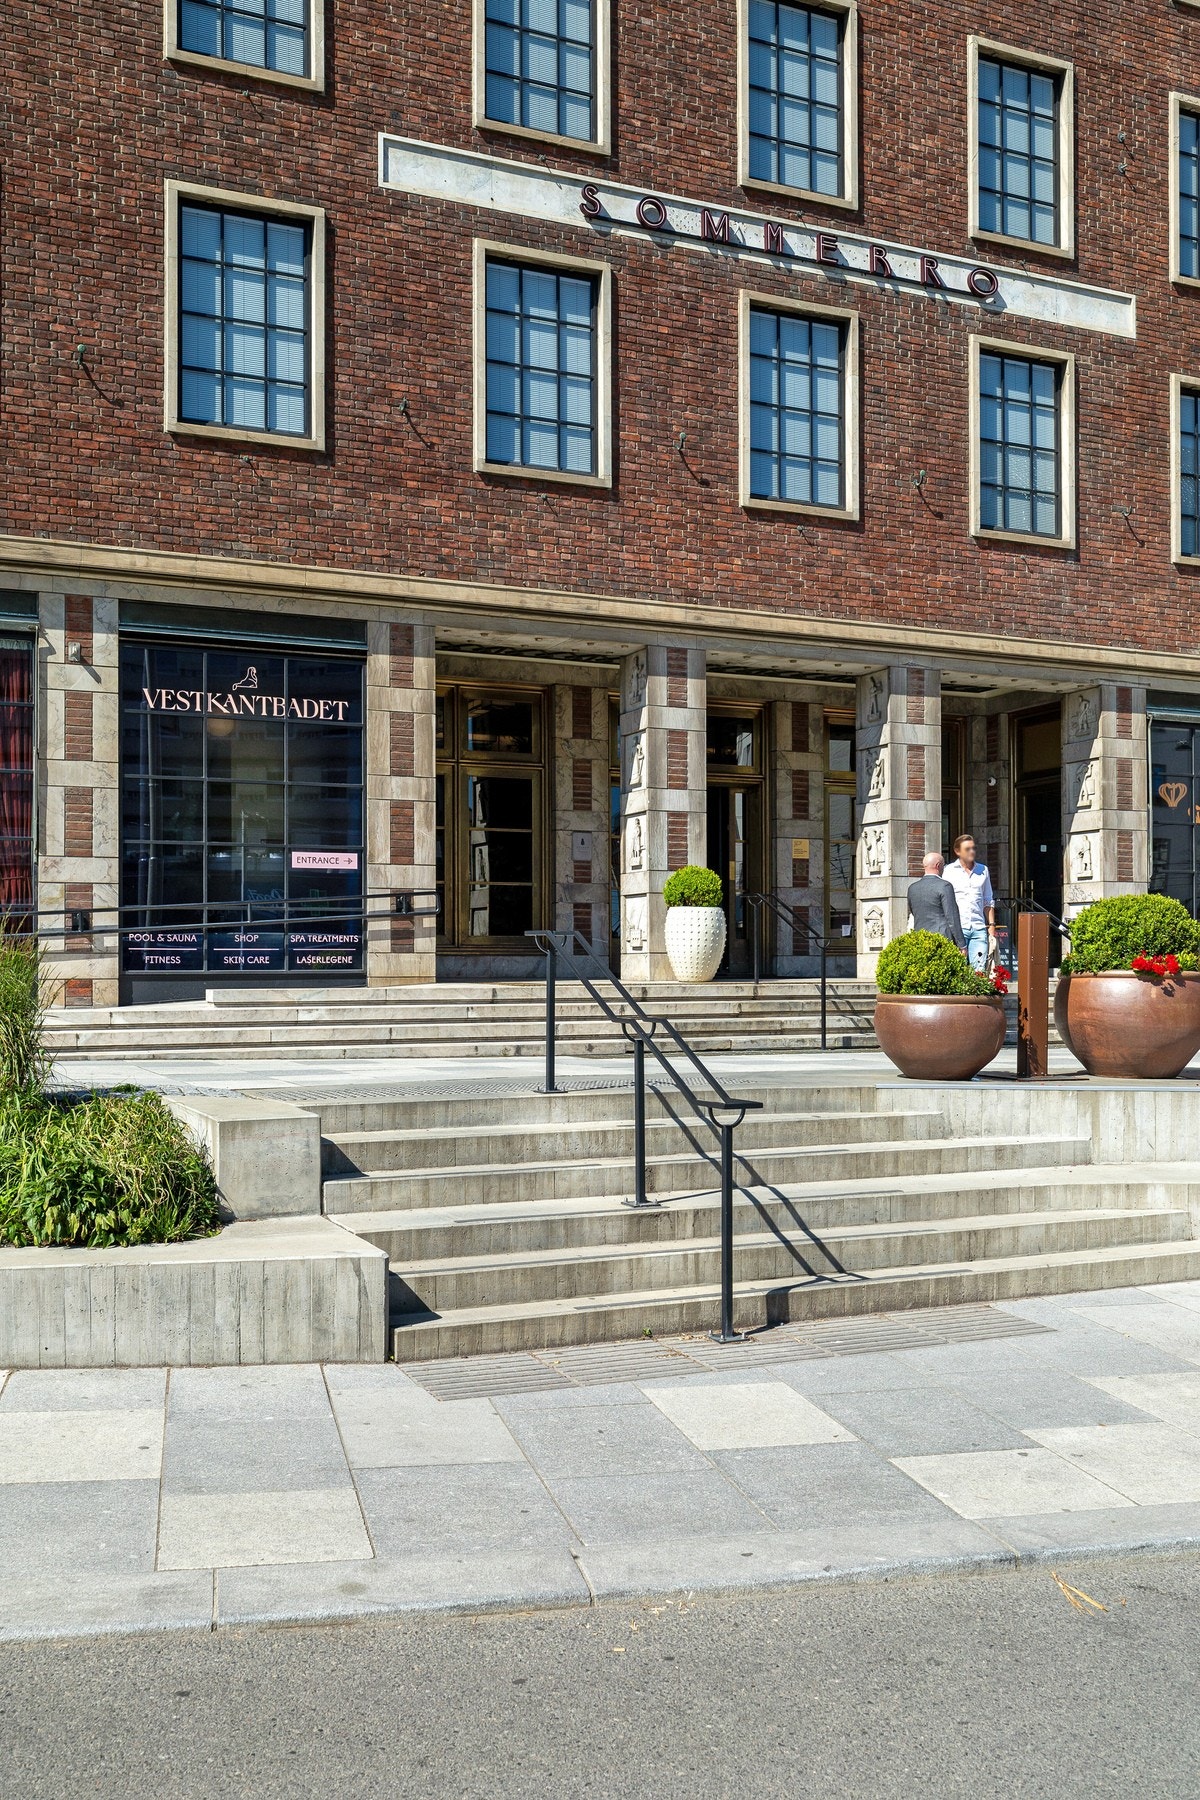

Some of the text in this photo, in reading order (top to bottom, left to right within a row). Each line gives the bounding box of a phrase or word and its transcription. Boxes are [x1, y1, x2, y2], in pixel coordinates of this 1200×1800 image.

[579, 183, 999, 298] SOMMERRO
[142, 687, 349, 721] VESTKANTBADET
[296, 856, 340, 865] ENTRANCE
[128, 933, 198, 943] POOL & SAUNA
[234, 934, 259, 943] SHOP
[290, 934, 359, 943] SPA TREATMENTS
[144, 955, 181, 964] FITNESS
[223, 955, 270, 964] SKIN CARE
[296, 955, 353, 964] LASERLEGENE
